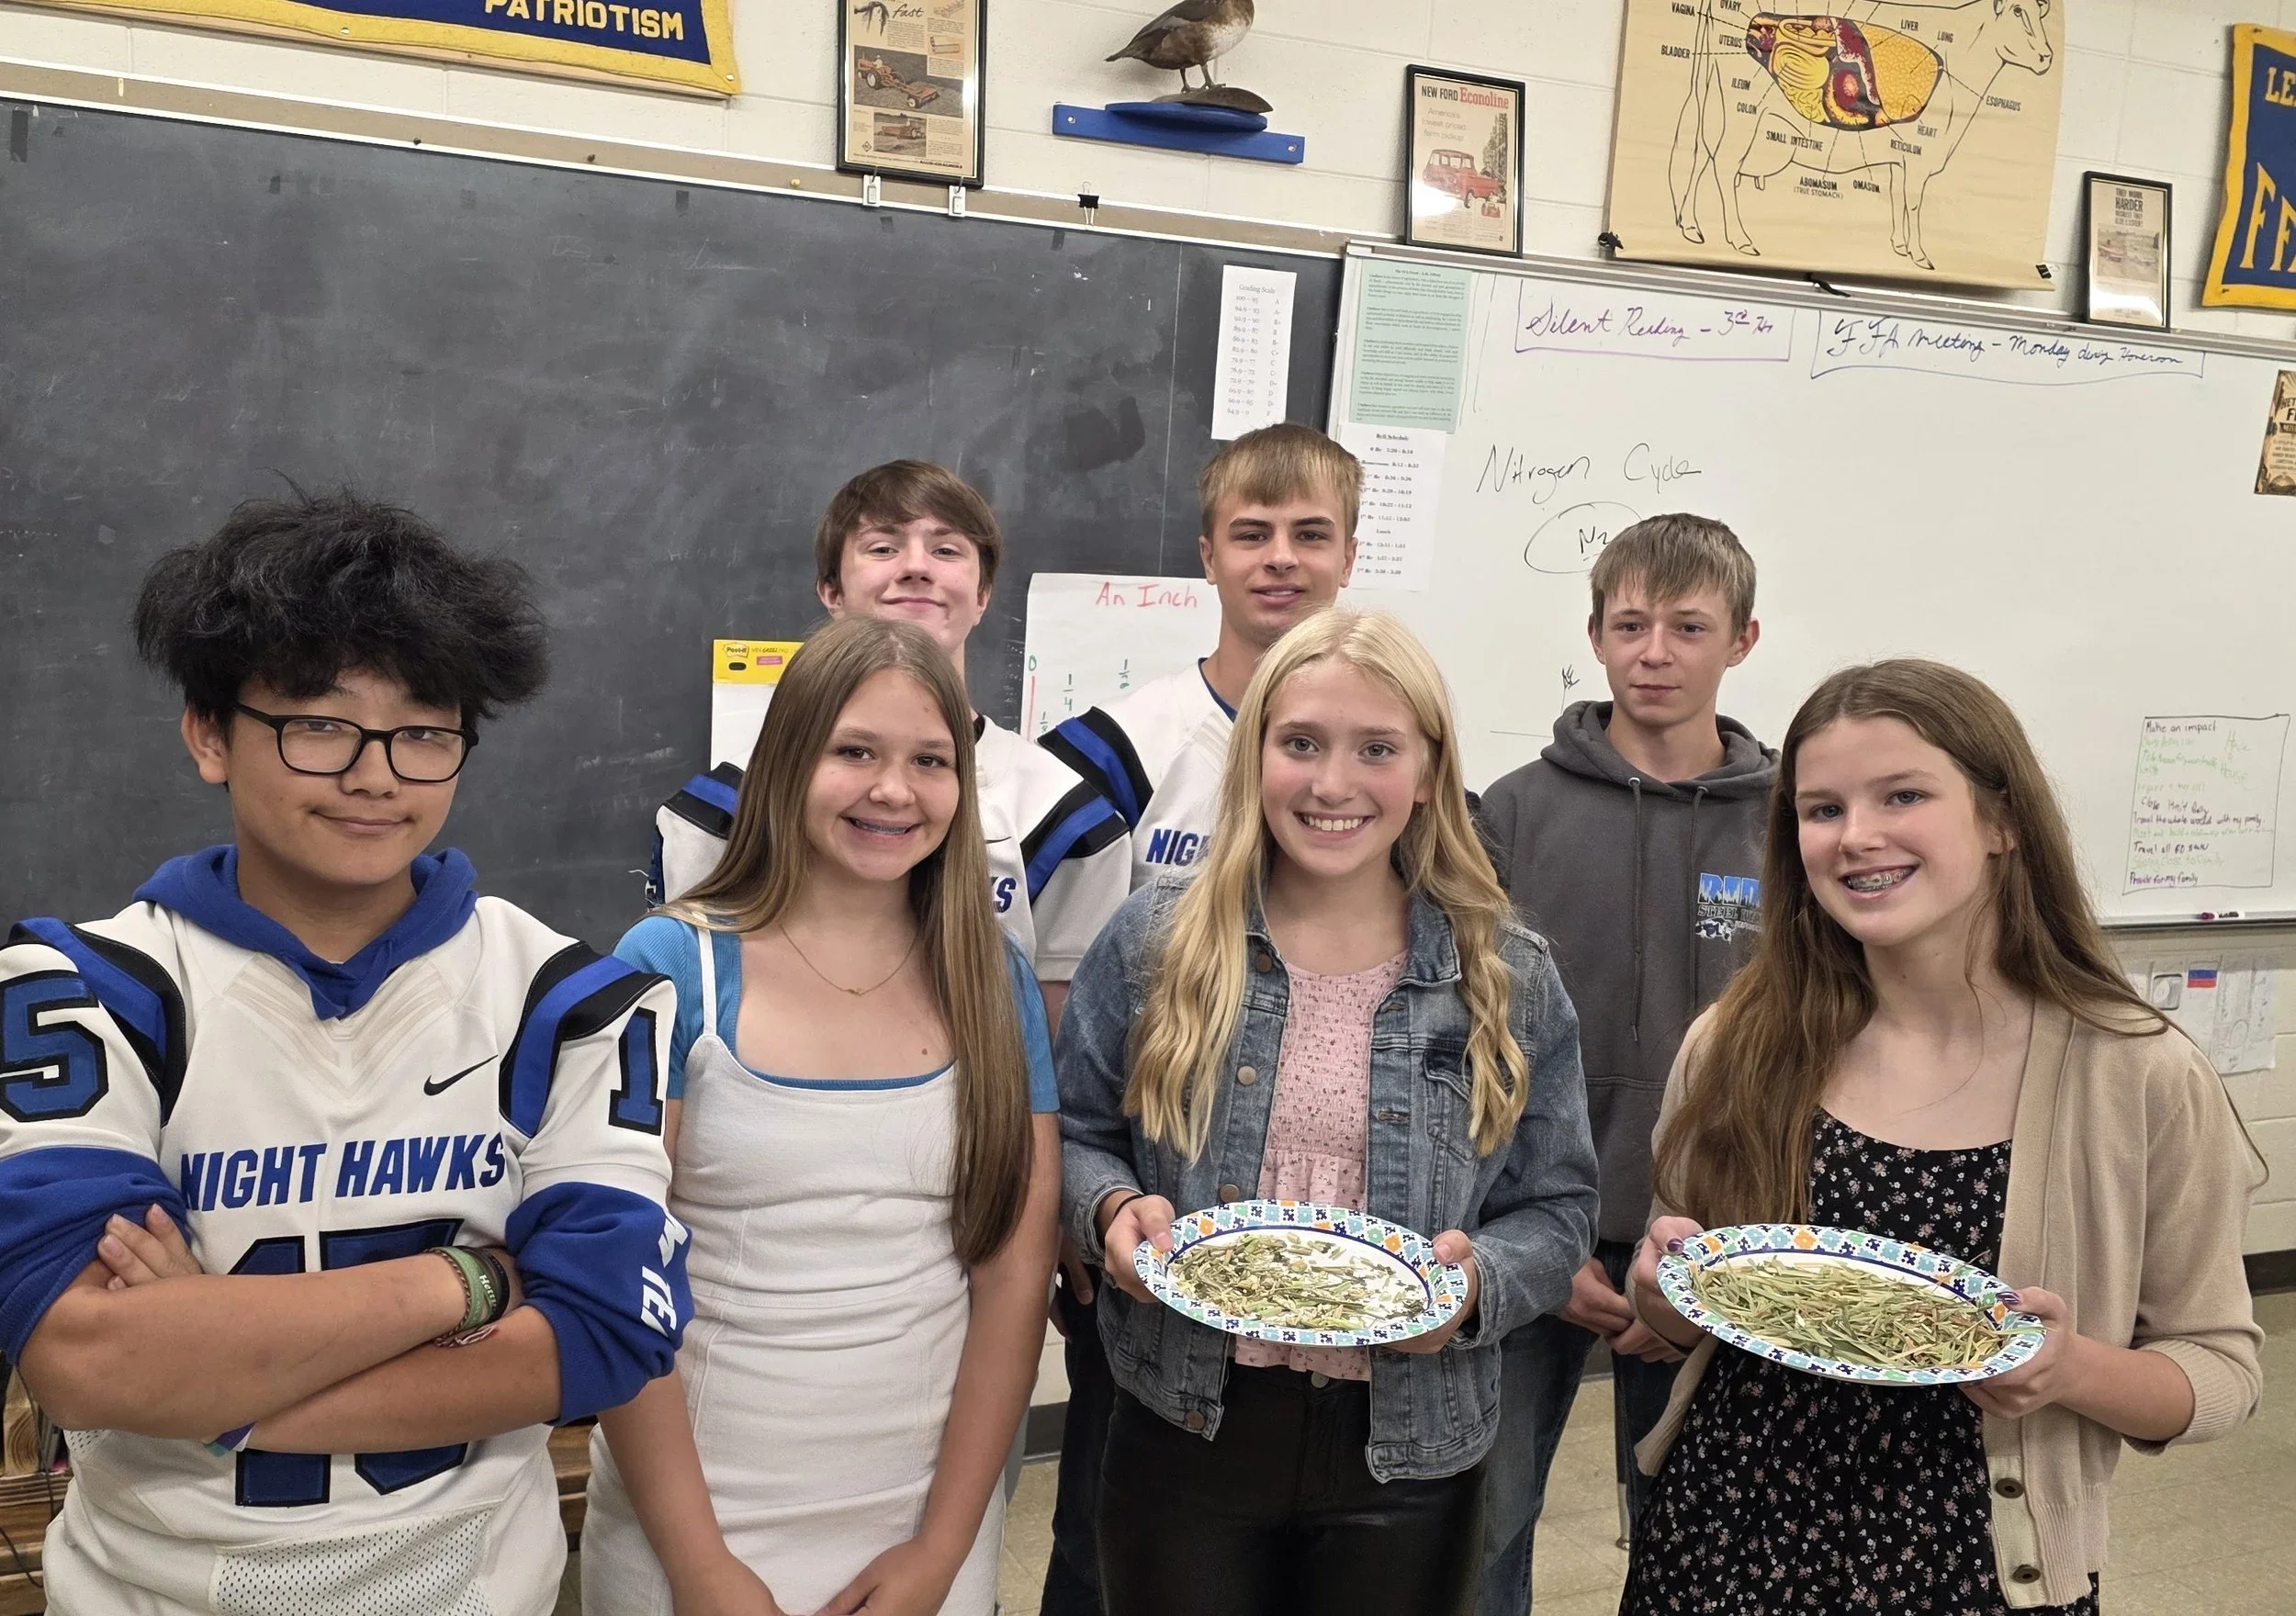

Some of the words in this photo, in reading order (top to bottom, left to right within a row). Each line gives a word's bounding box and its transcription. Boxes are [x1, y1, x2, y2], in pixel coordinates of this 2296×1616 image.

[892, 3, 925, 19] fast
[1671, 2, 1695, 17] VAGINA
[1719, 0, 1742, 12] OVARY
[1900, 18, 1919, 31] LIVER
[1718, 34, 1743, 49] UTERUS
[1937, 30, 1954, 43] LUNG
[1660, 44, 1691, 59] BLADDER
[1731, 77, 1751, 91] ILEUM
[2265, 66, 2296, 107] LE
[1421, 85, 1437, 98] NEW
[1440, 87, 1458, 101] FORD
[1459, 86, 1509, 109] Econoline
[1986, 95, 2021, 112] ESOPHAGUS
[1736, 101, 1758, 115] COLON
[1917, 124, 1938, 138] HEART
[1766, 130, 1787, 144] SMALL
[1791, 135, 1824, 152] INTESTINE
[1890, 139, 1922, 155] RETICULUM
[1799, 175, 1838, 191] ABOMASUM
[1852, 179, 1881, 194] OMASUM
[1811, 188, 1844, 200] STOMACH)
[2115, 196, 2144, 212] HARDER
[2239, 162, 2296, 273] FF
[1525, 296, 1613, 337] Silent
[1618, 306, 1692, 347] Reading
[2009, 334, 2070, 368] Monday
[1476, 443, 1591, 504] Nitrogen
[1624, 443, 1702, 494] Cycle
[1096, 581, 1125, 606] An
[1136, 583, 1198, 608] Inch
[2145, 721, 2167, 734] Make
[2185, 720, 2216, 735] impact
[1145, 828, 1211, 866] NIG
[2133, 840, 2157, 855] Travel
[1697, 904, 1739, 919] STEEL
[181, 1143, 327, 1212] NIGHT
[334, 1131, 506, 1198] HAWKS
